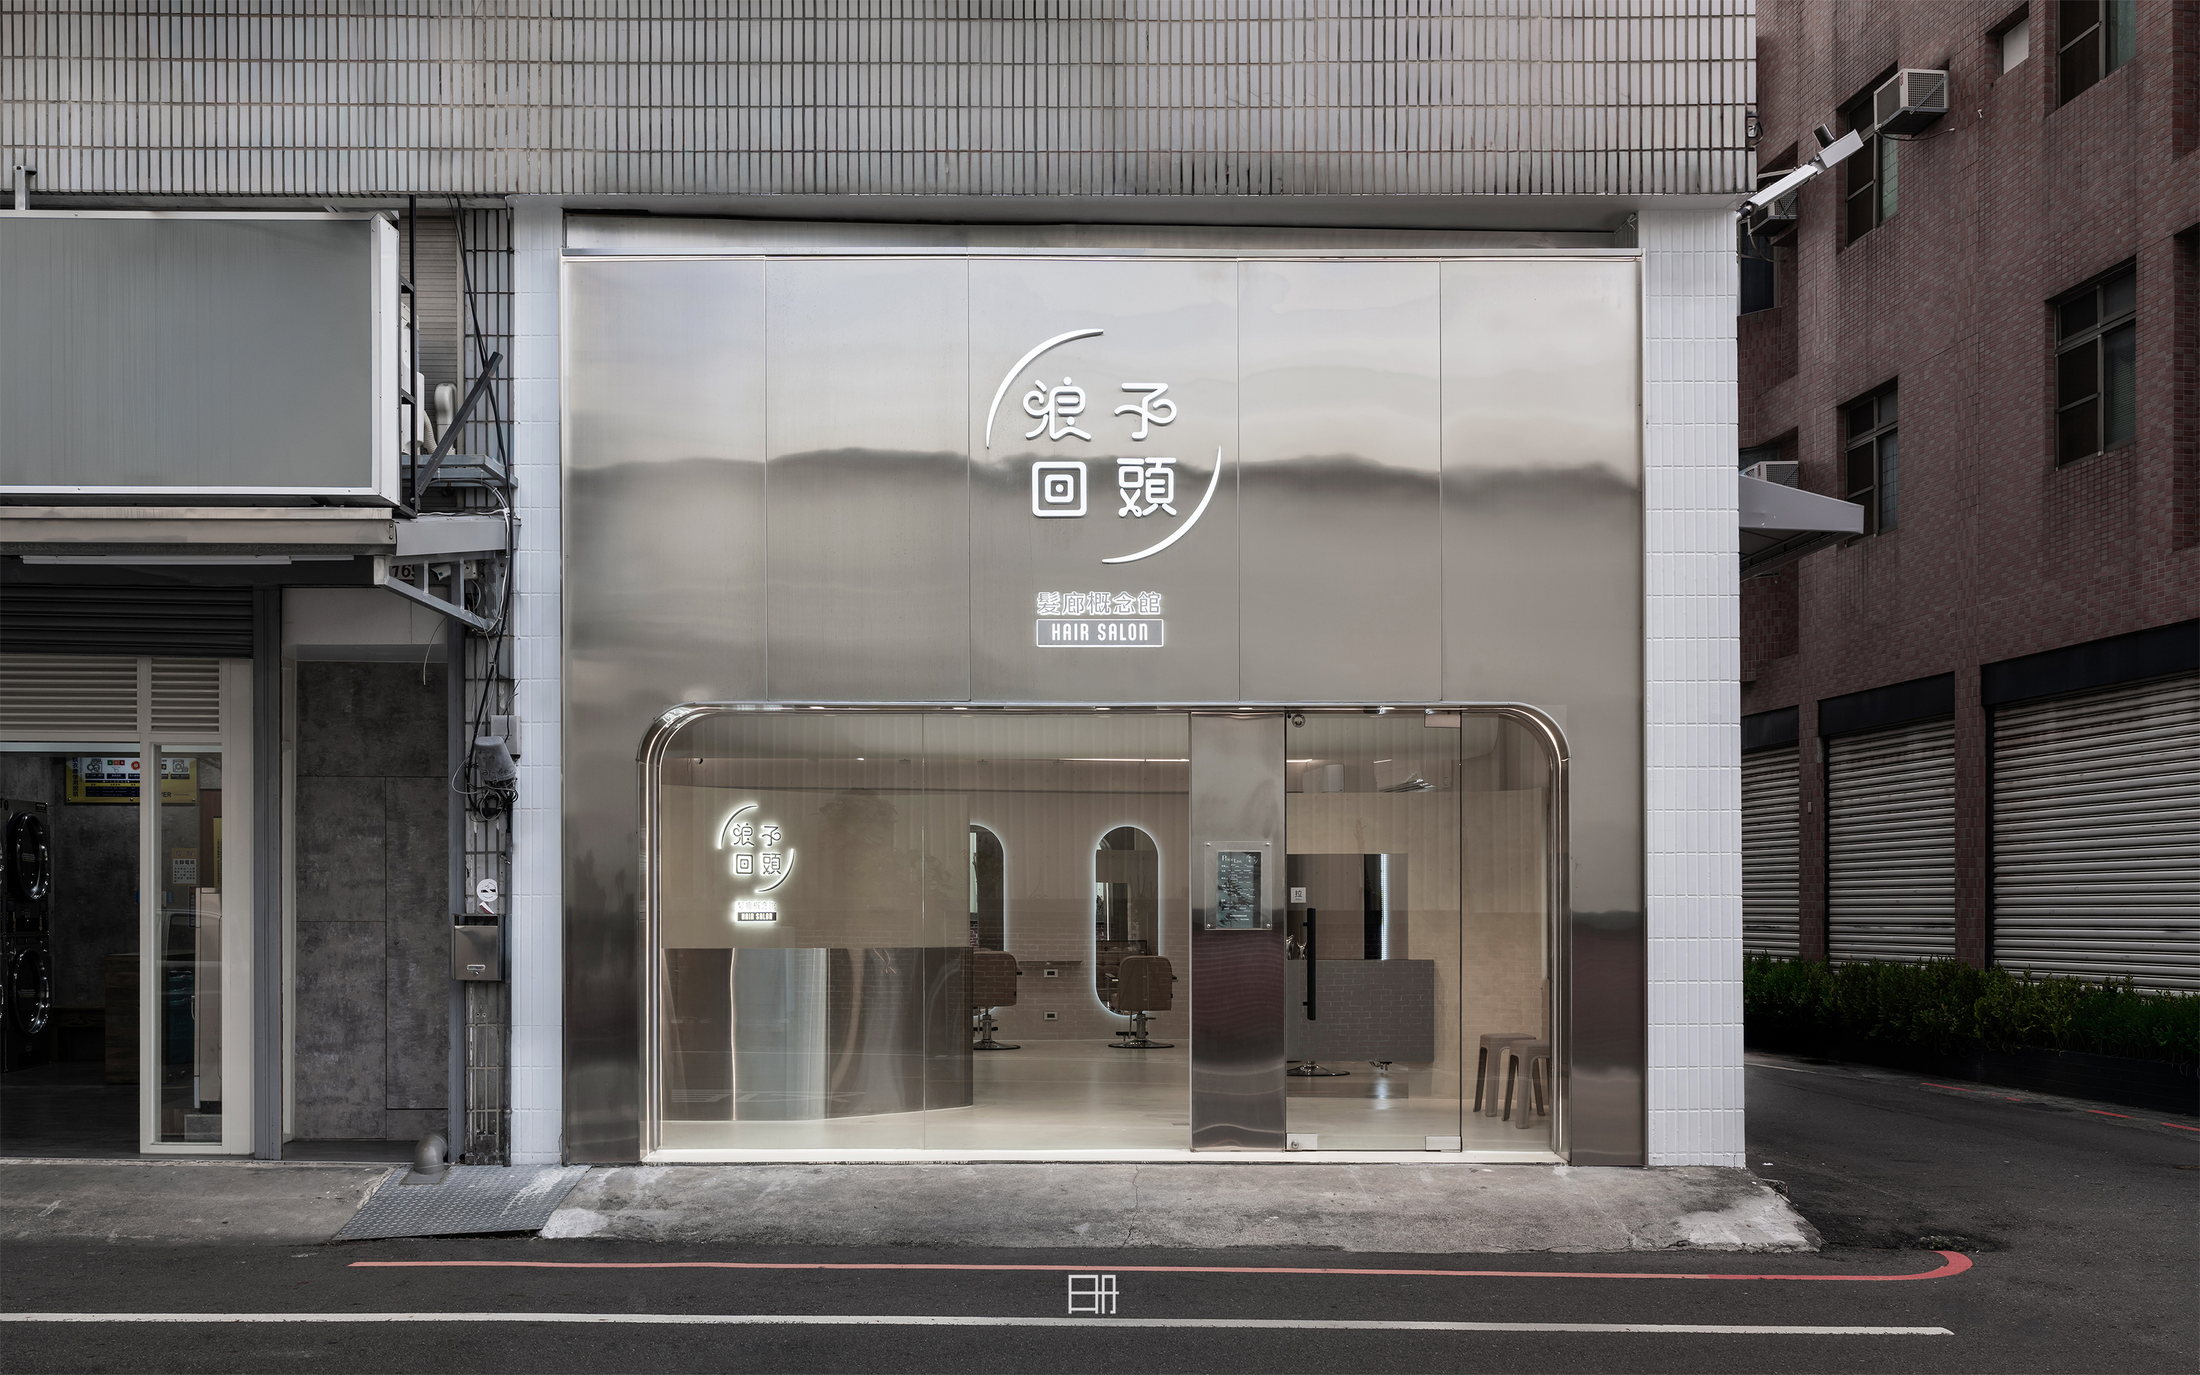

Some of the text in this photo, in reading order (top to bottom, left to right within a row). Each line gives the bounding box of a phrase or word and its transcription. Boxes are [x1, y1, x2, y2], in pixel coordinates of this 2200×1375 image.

[1023, 376, 1177, 441] 浪子
[1032, 457, 1177, 518] 回頭
[1036, 591, 1162, 616] 髮廊概念館
[1051, 623, 1148, 641] HAIR SALON
[732, 822, 782, 847] 浪子
[735, 852, 782, 875] 回頭
[1294, 889, 1303, 897] 拉
